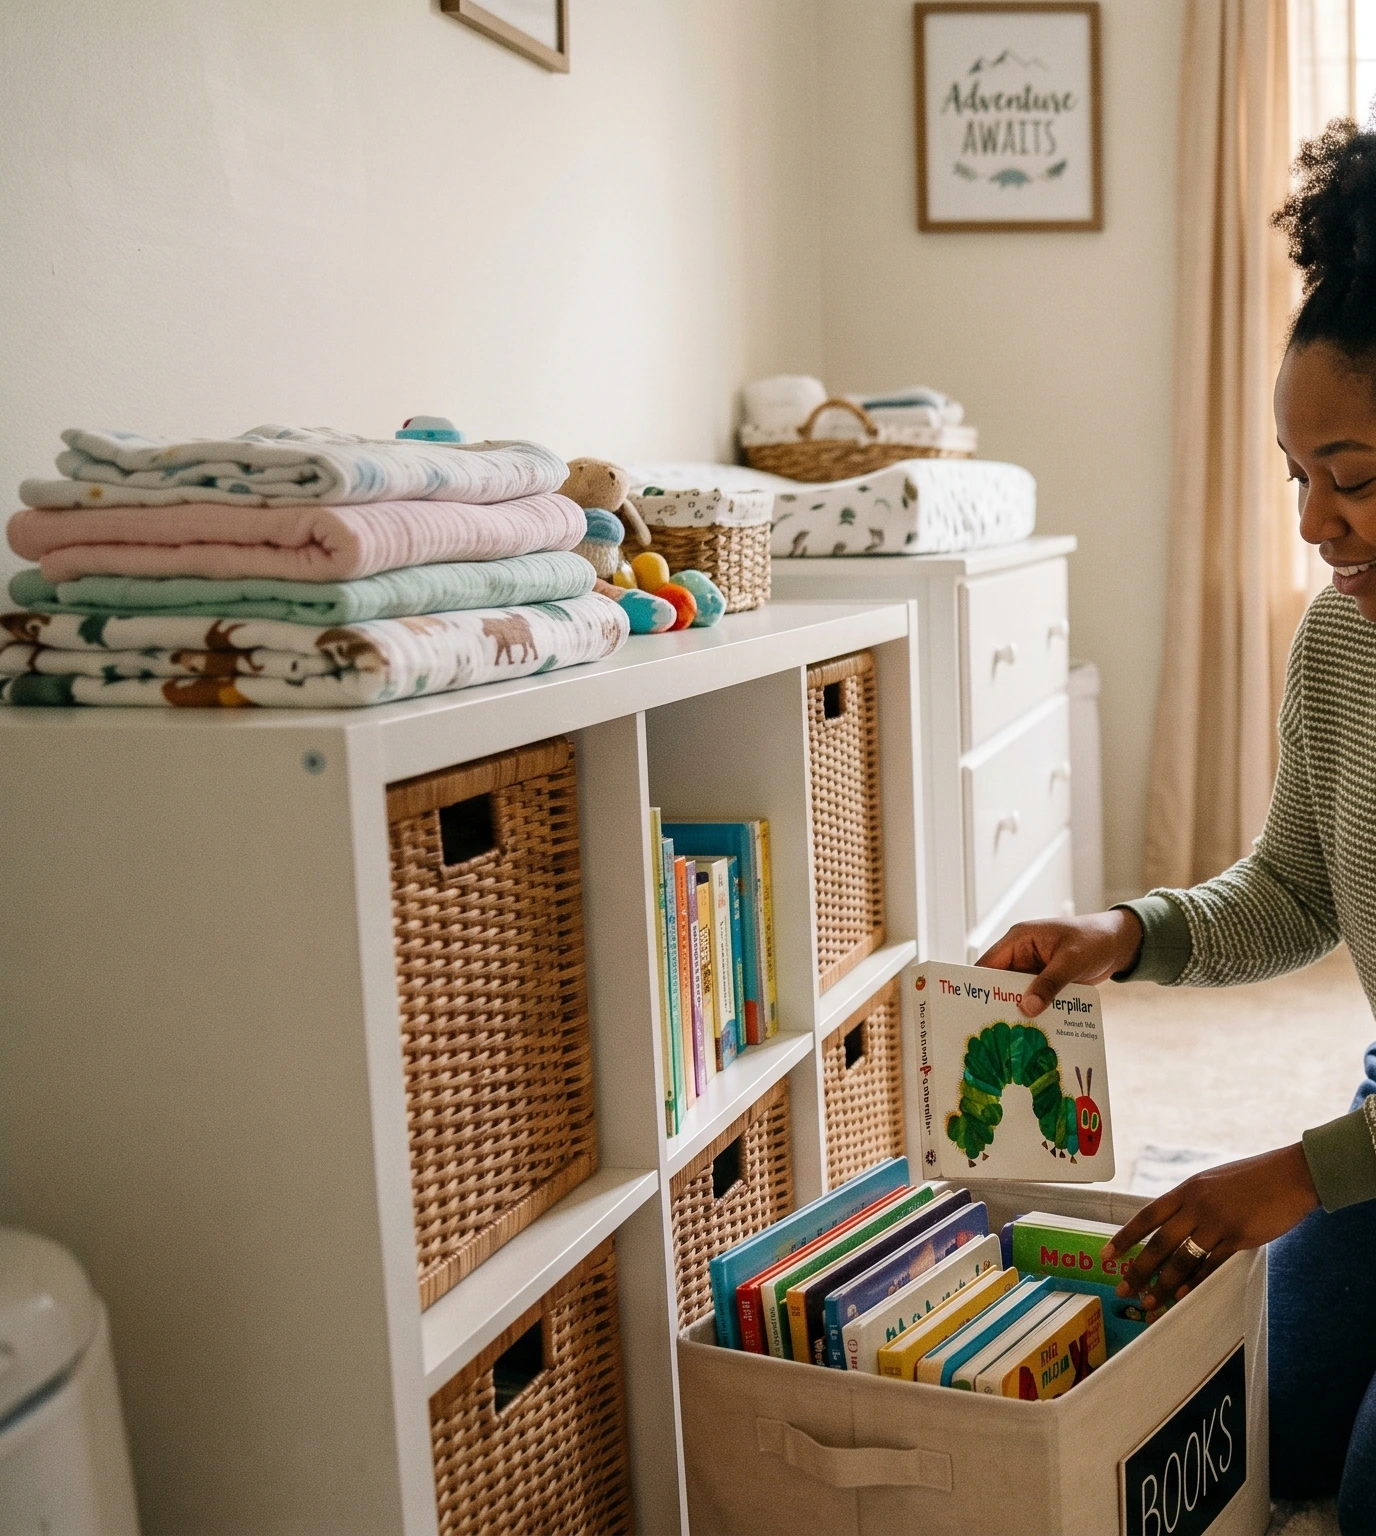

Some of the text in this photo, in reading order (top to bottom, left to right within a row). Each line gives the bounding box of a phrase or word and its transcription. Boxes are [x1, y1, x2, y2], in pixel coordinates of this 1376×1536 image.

[941, 80, 1075, 115] Adventure
[962, 119, 1057, 155] AWAITS
[939, 979, 1093, 1015] The Very Hung terpillar
[1141, 1394, 1233, 1536] BOOKS
